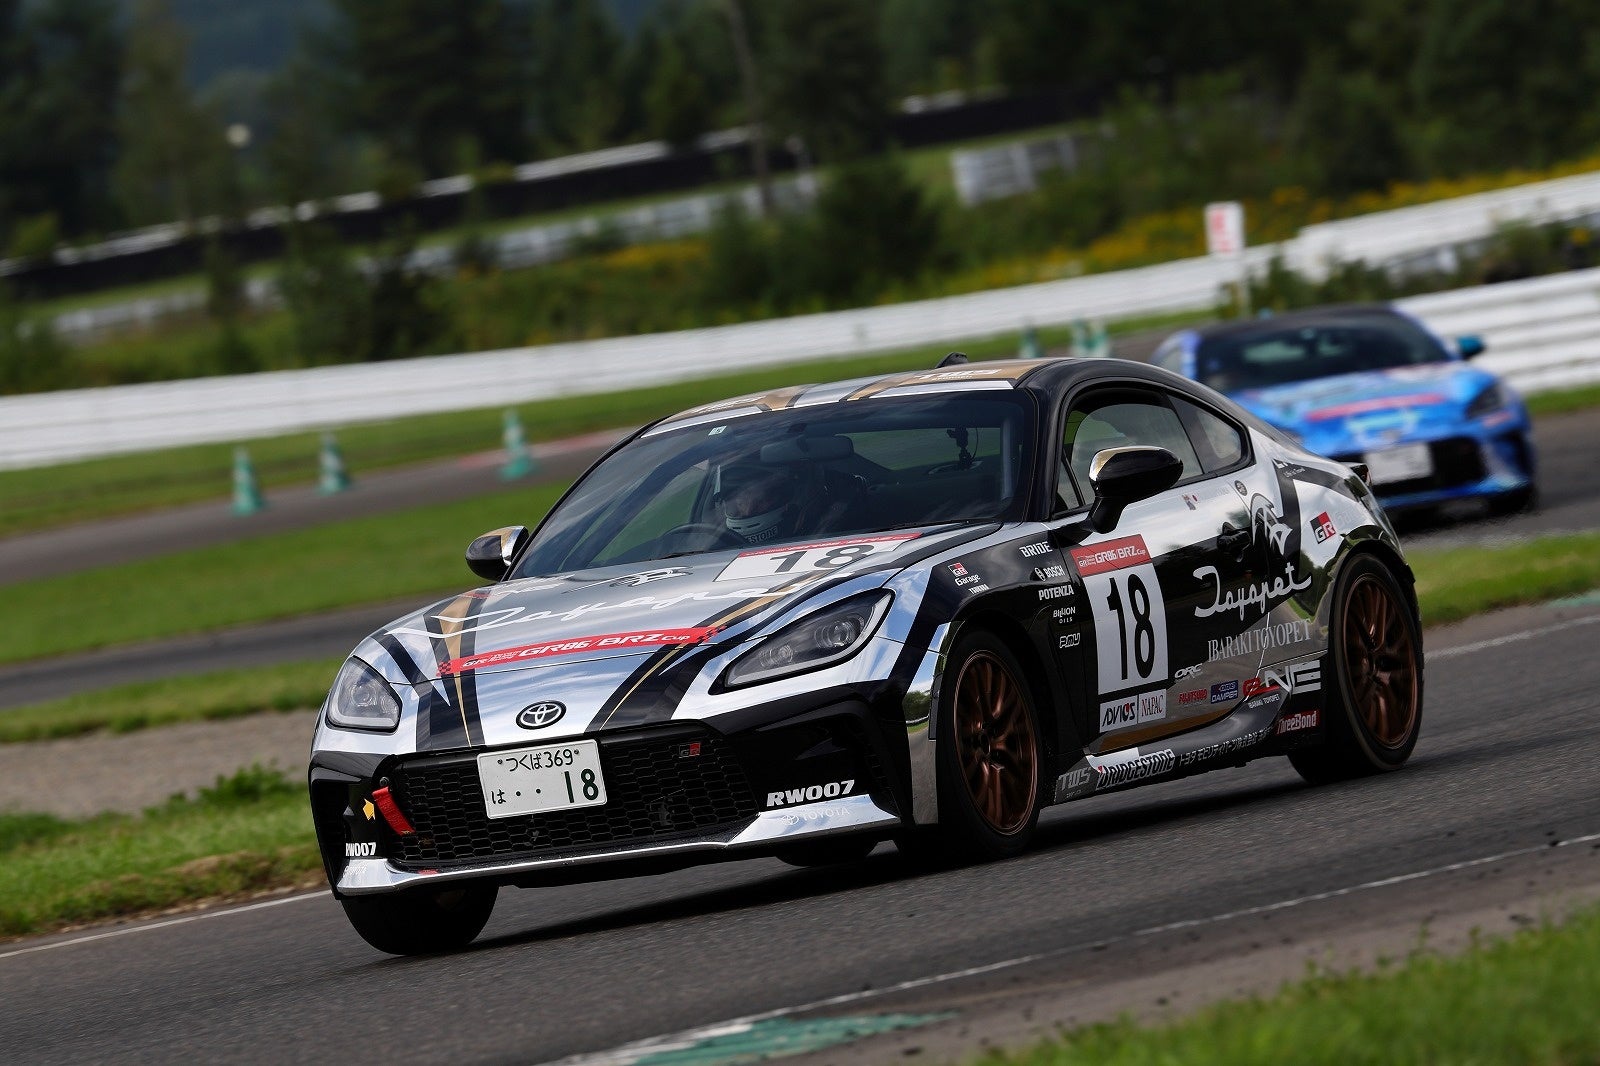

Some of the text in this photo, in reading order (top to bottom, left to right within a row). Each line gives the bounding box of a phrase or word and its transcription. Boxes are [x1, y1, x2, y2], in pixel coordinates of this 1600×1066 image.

[1314, 521, 1336, 543] GR
[770, 545, 875, 573] 18
[1019, 541, 1053, 557] BRIDE
[954, 574, 980, 586] Garage
[1044, 565, 1065, 578] BOSCH
[1038, 585, 1075, 600] POTENZA
[1193, 562, 1312, 621] Toyopet
[1053, 606, 1076, 618] BILLION
[1106, 573, 1155, 681] 18
[661, 635, 690, 643] Cup
[1207, 618, 1312, 664] IBARAKI TOYOPET
[1141, 695, 1164, 717] NAPAC
[1276, 710, 1317, 734] ThreeBond
[564, 768, 599, 803] 18
[1058, 767, 1091, 791] TWS
[802, 808, 850, 822] TOYOTA
